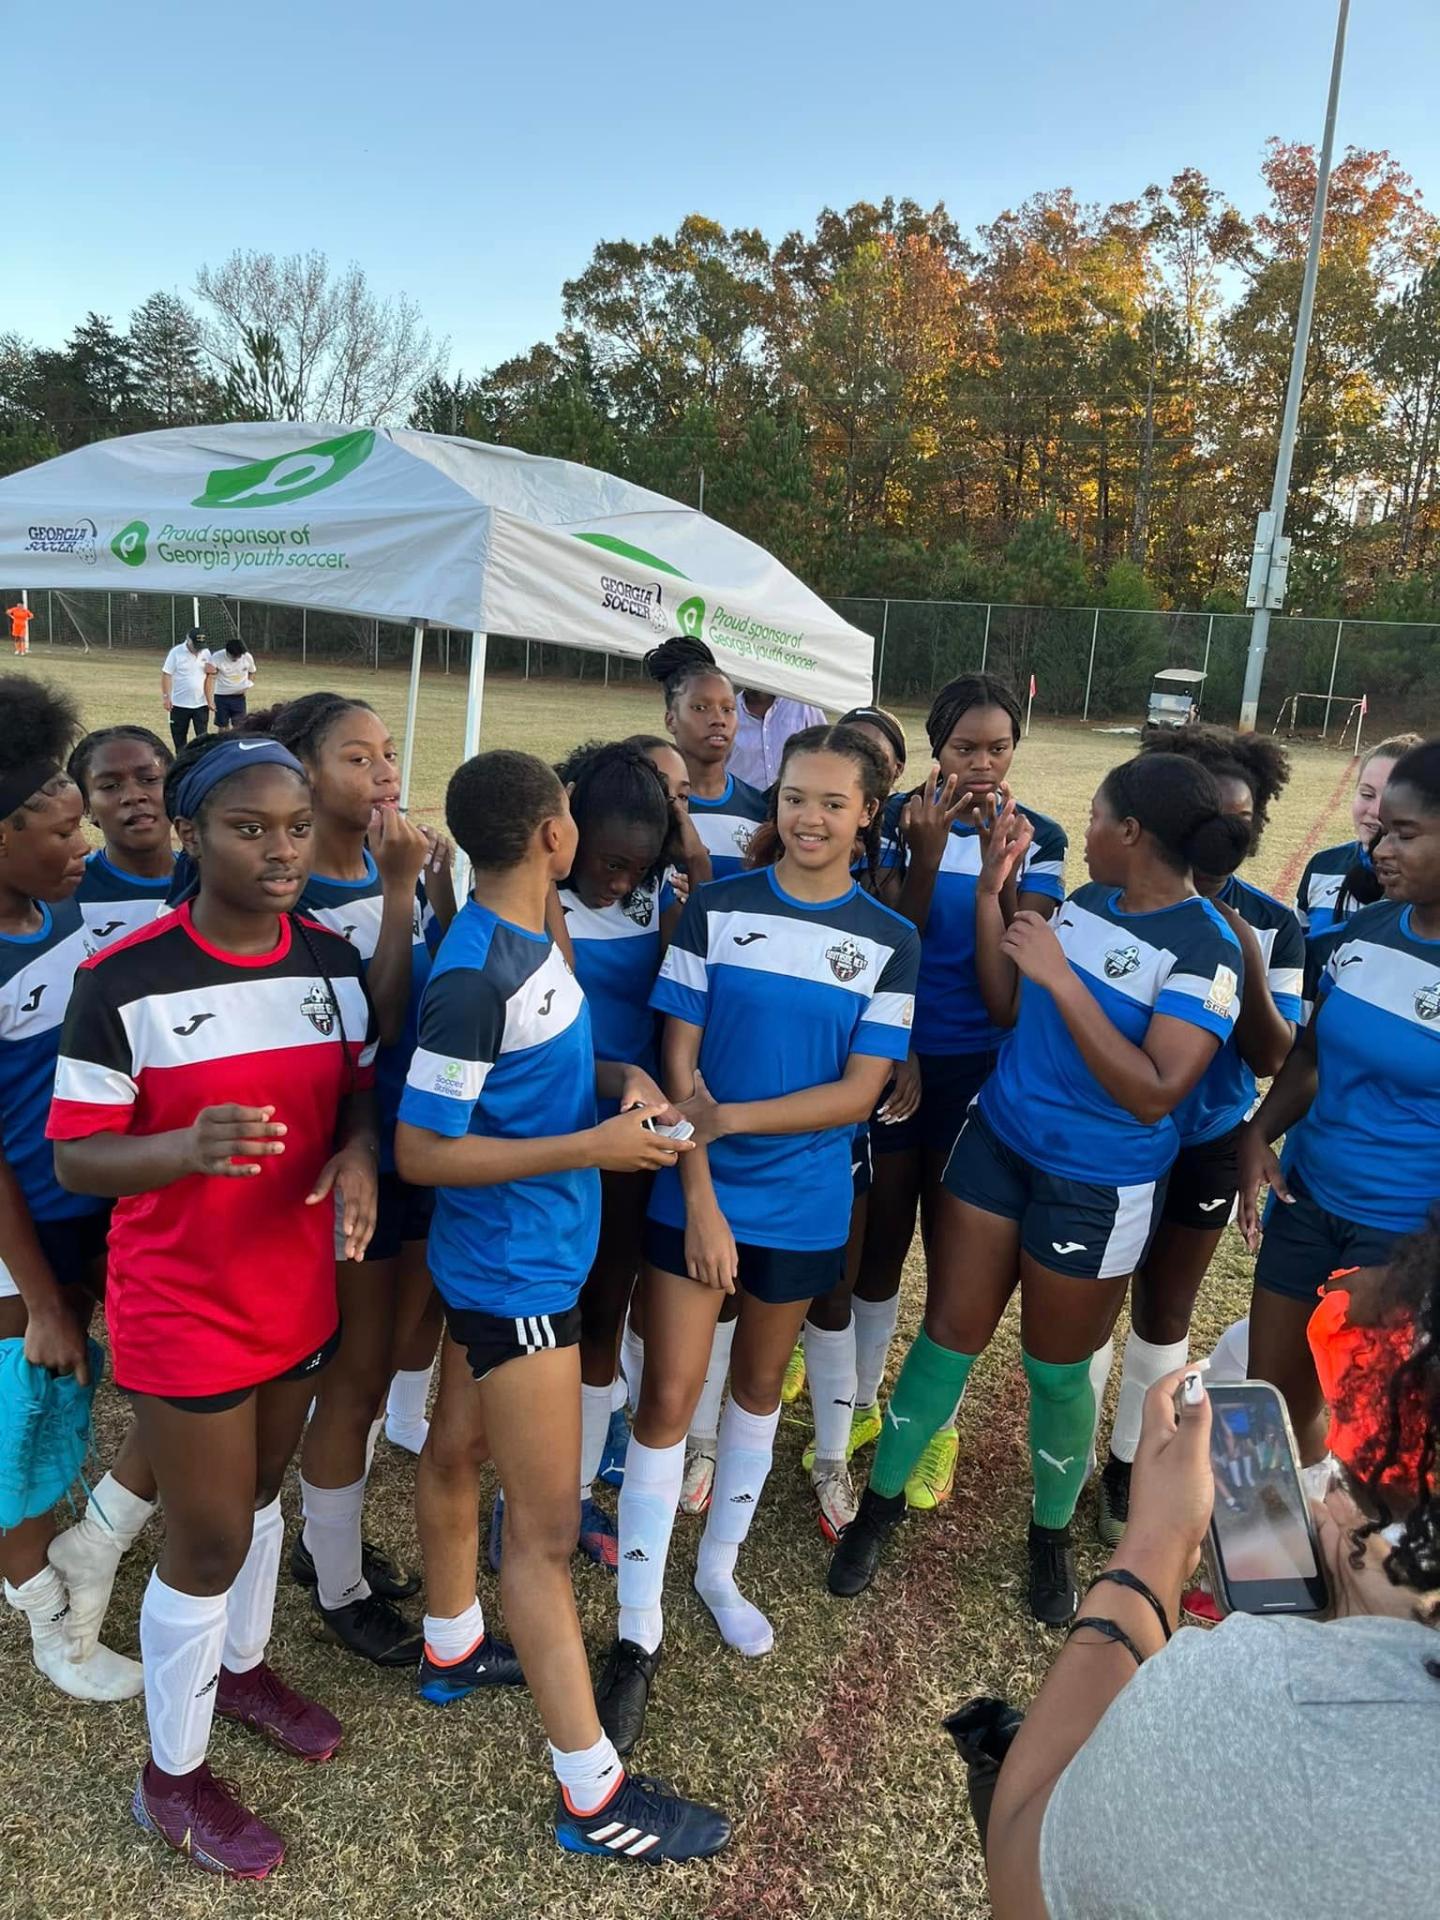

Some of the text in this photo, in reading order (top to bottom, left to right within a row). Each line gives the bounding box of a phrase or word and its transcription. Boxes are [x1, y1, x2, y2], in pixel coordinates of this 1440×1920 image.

[28, 526, 87, 541] GEORGIA
[157, 524, 311, 548] Proud sponsor of
[157, 542, 350, 571] Georgia youth soccer.
[600, 576, 653, 605] GEORGIA
[601, 592, 651, 619] SOCCER
[711, 606, 805, 649] Proud sponsor of
[708, 626, 818, 672] Georgia youth soccer.
